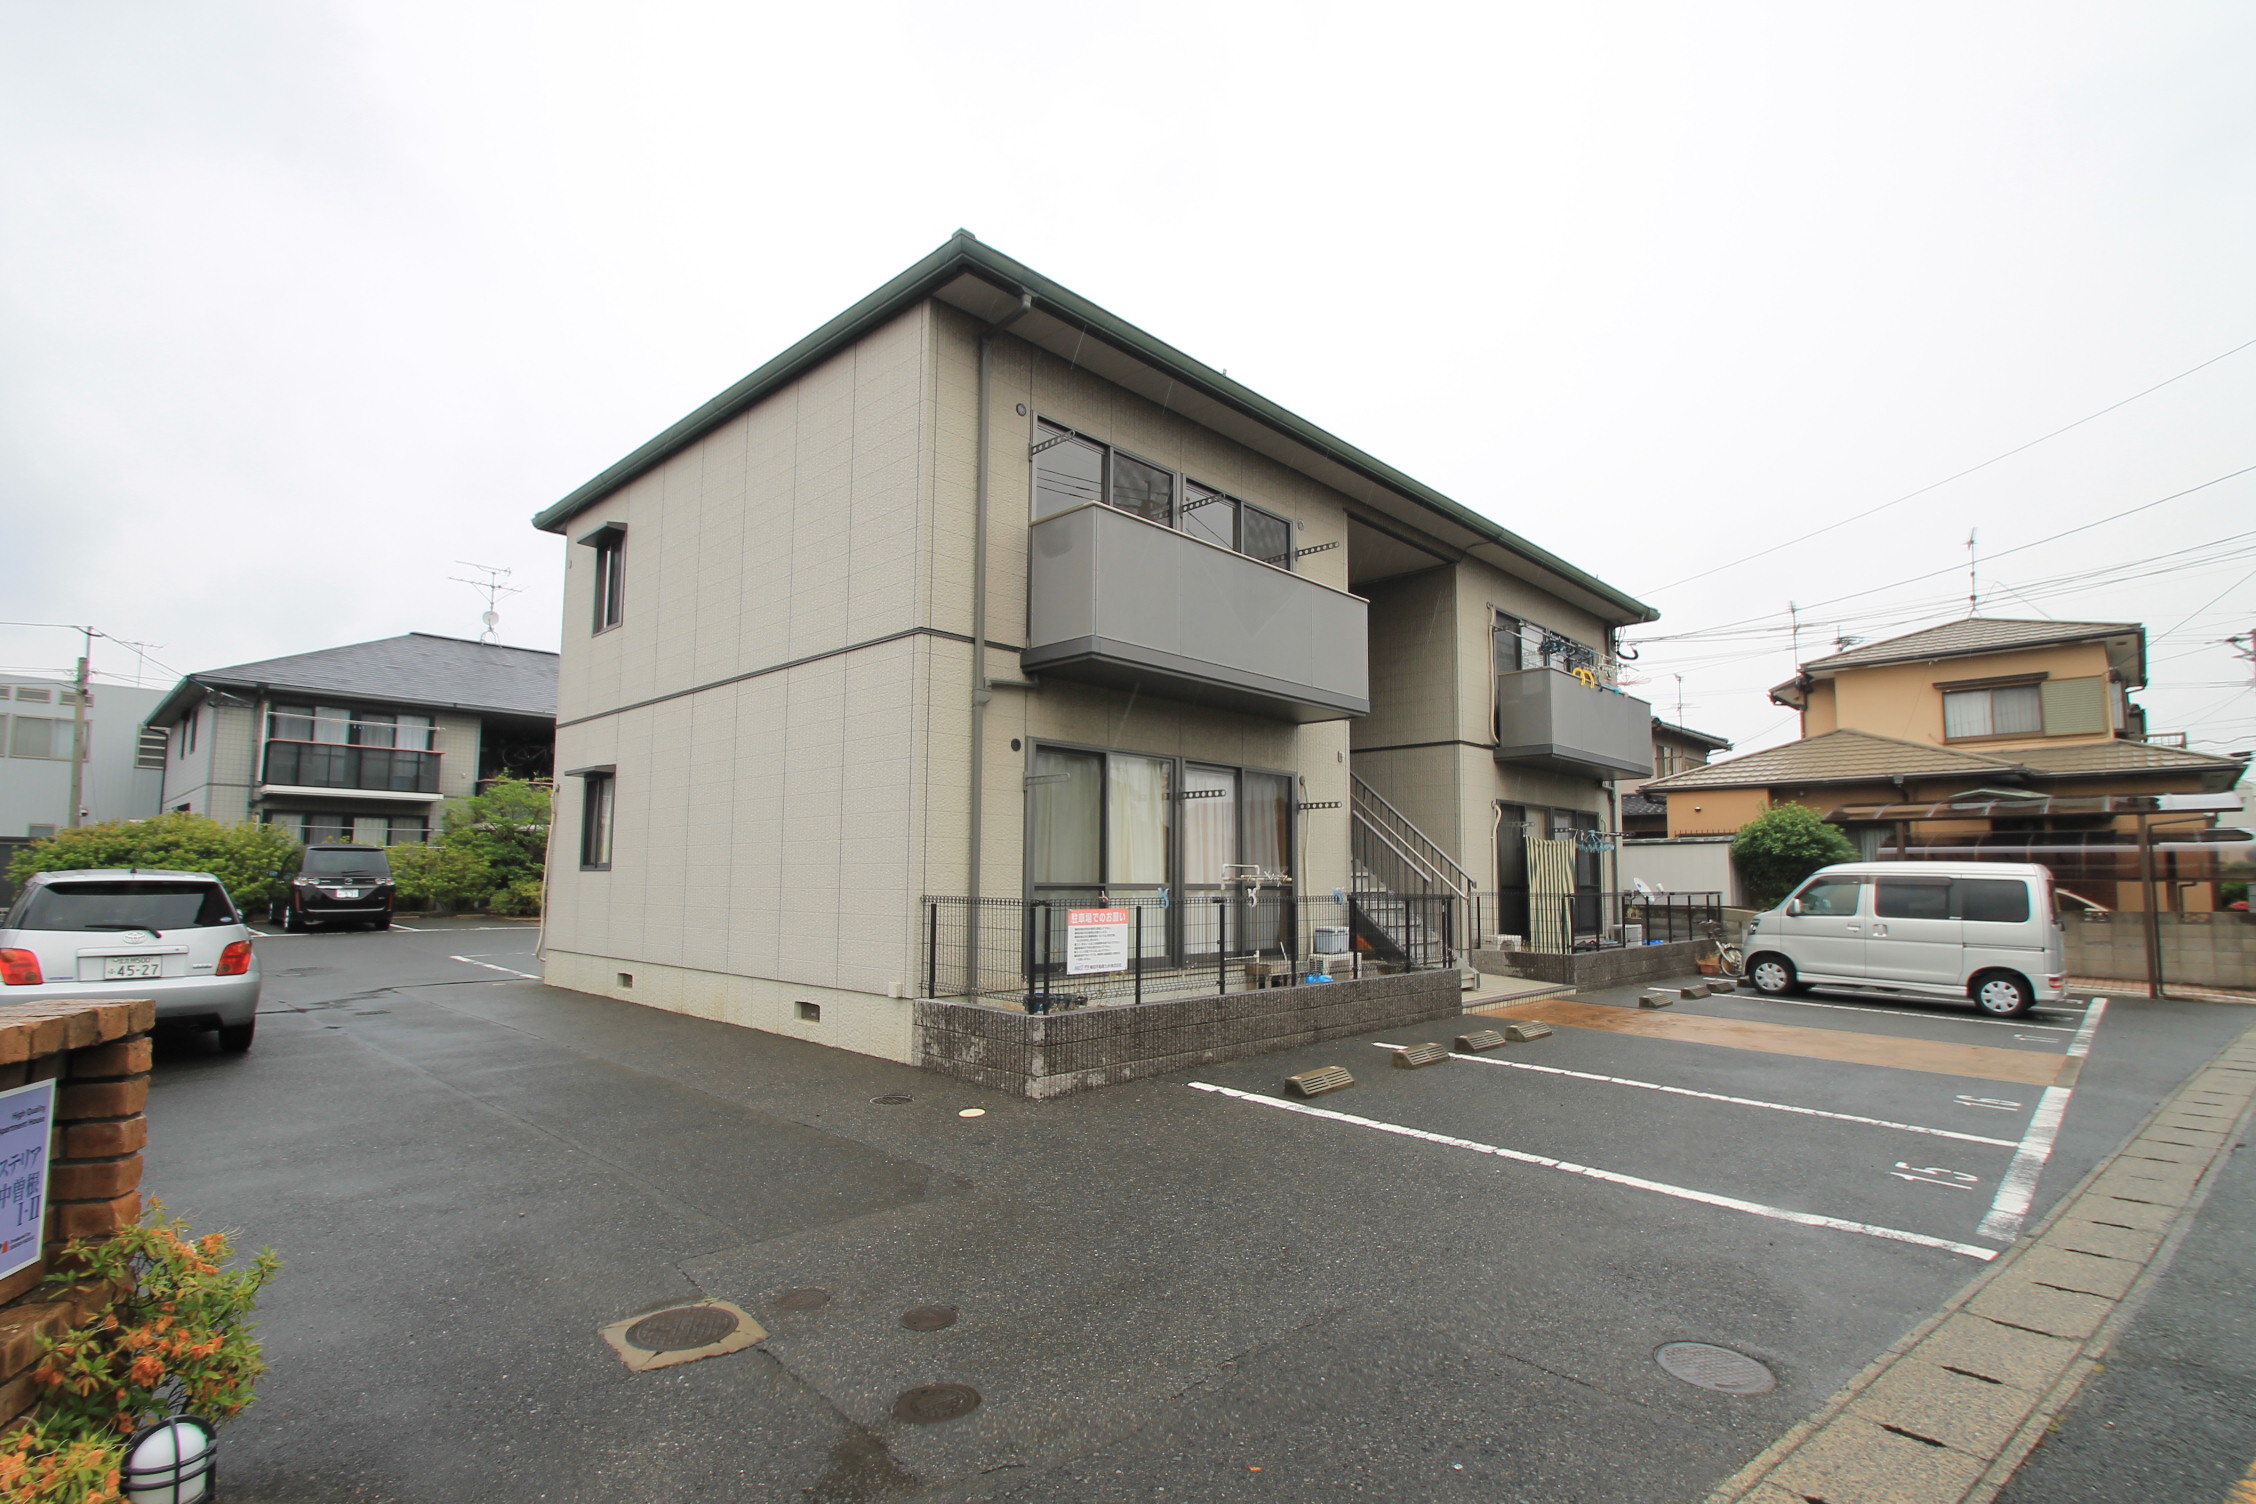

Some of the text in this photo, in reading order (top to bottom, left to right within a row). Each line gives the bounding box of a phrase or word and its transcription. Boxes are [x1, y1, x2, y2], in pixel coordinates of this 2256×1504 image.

[118, 965, 159, 976] 45-27
[1953, 1095, 2024, 1112] 16
[1890, 1162, 1979, 1190] 15
[0, 1170, 39, 1208] 中曽根
